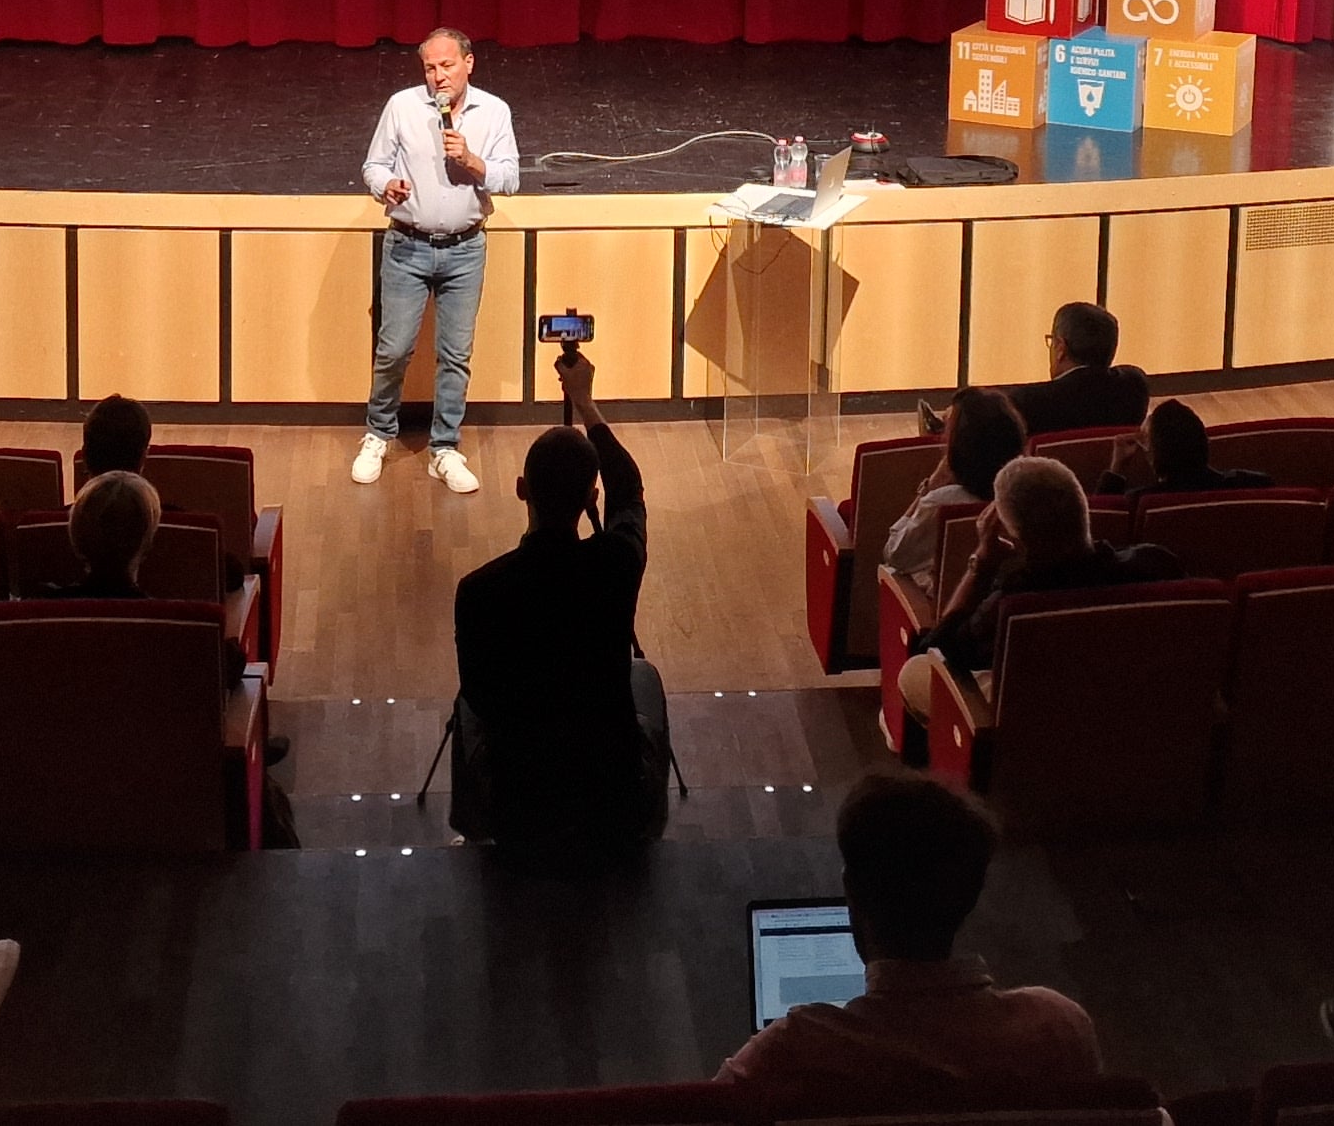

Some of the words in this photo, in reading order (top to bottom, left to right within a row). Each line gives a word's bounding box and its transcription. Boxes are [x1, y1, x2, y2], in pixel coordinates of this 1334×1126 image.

[957, 41, 971, 60] 11
[1055, 44, 1066, 63] 6
[1154, 48, 1164, 67] 7
